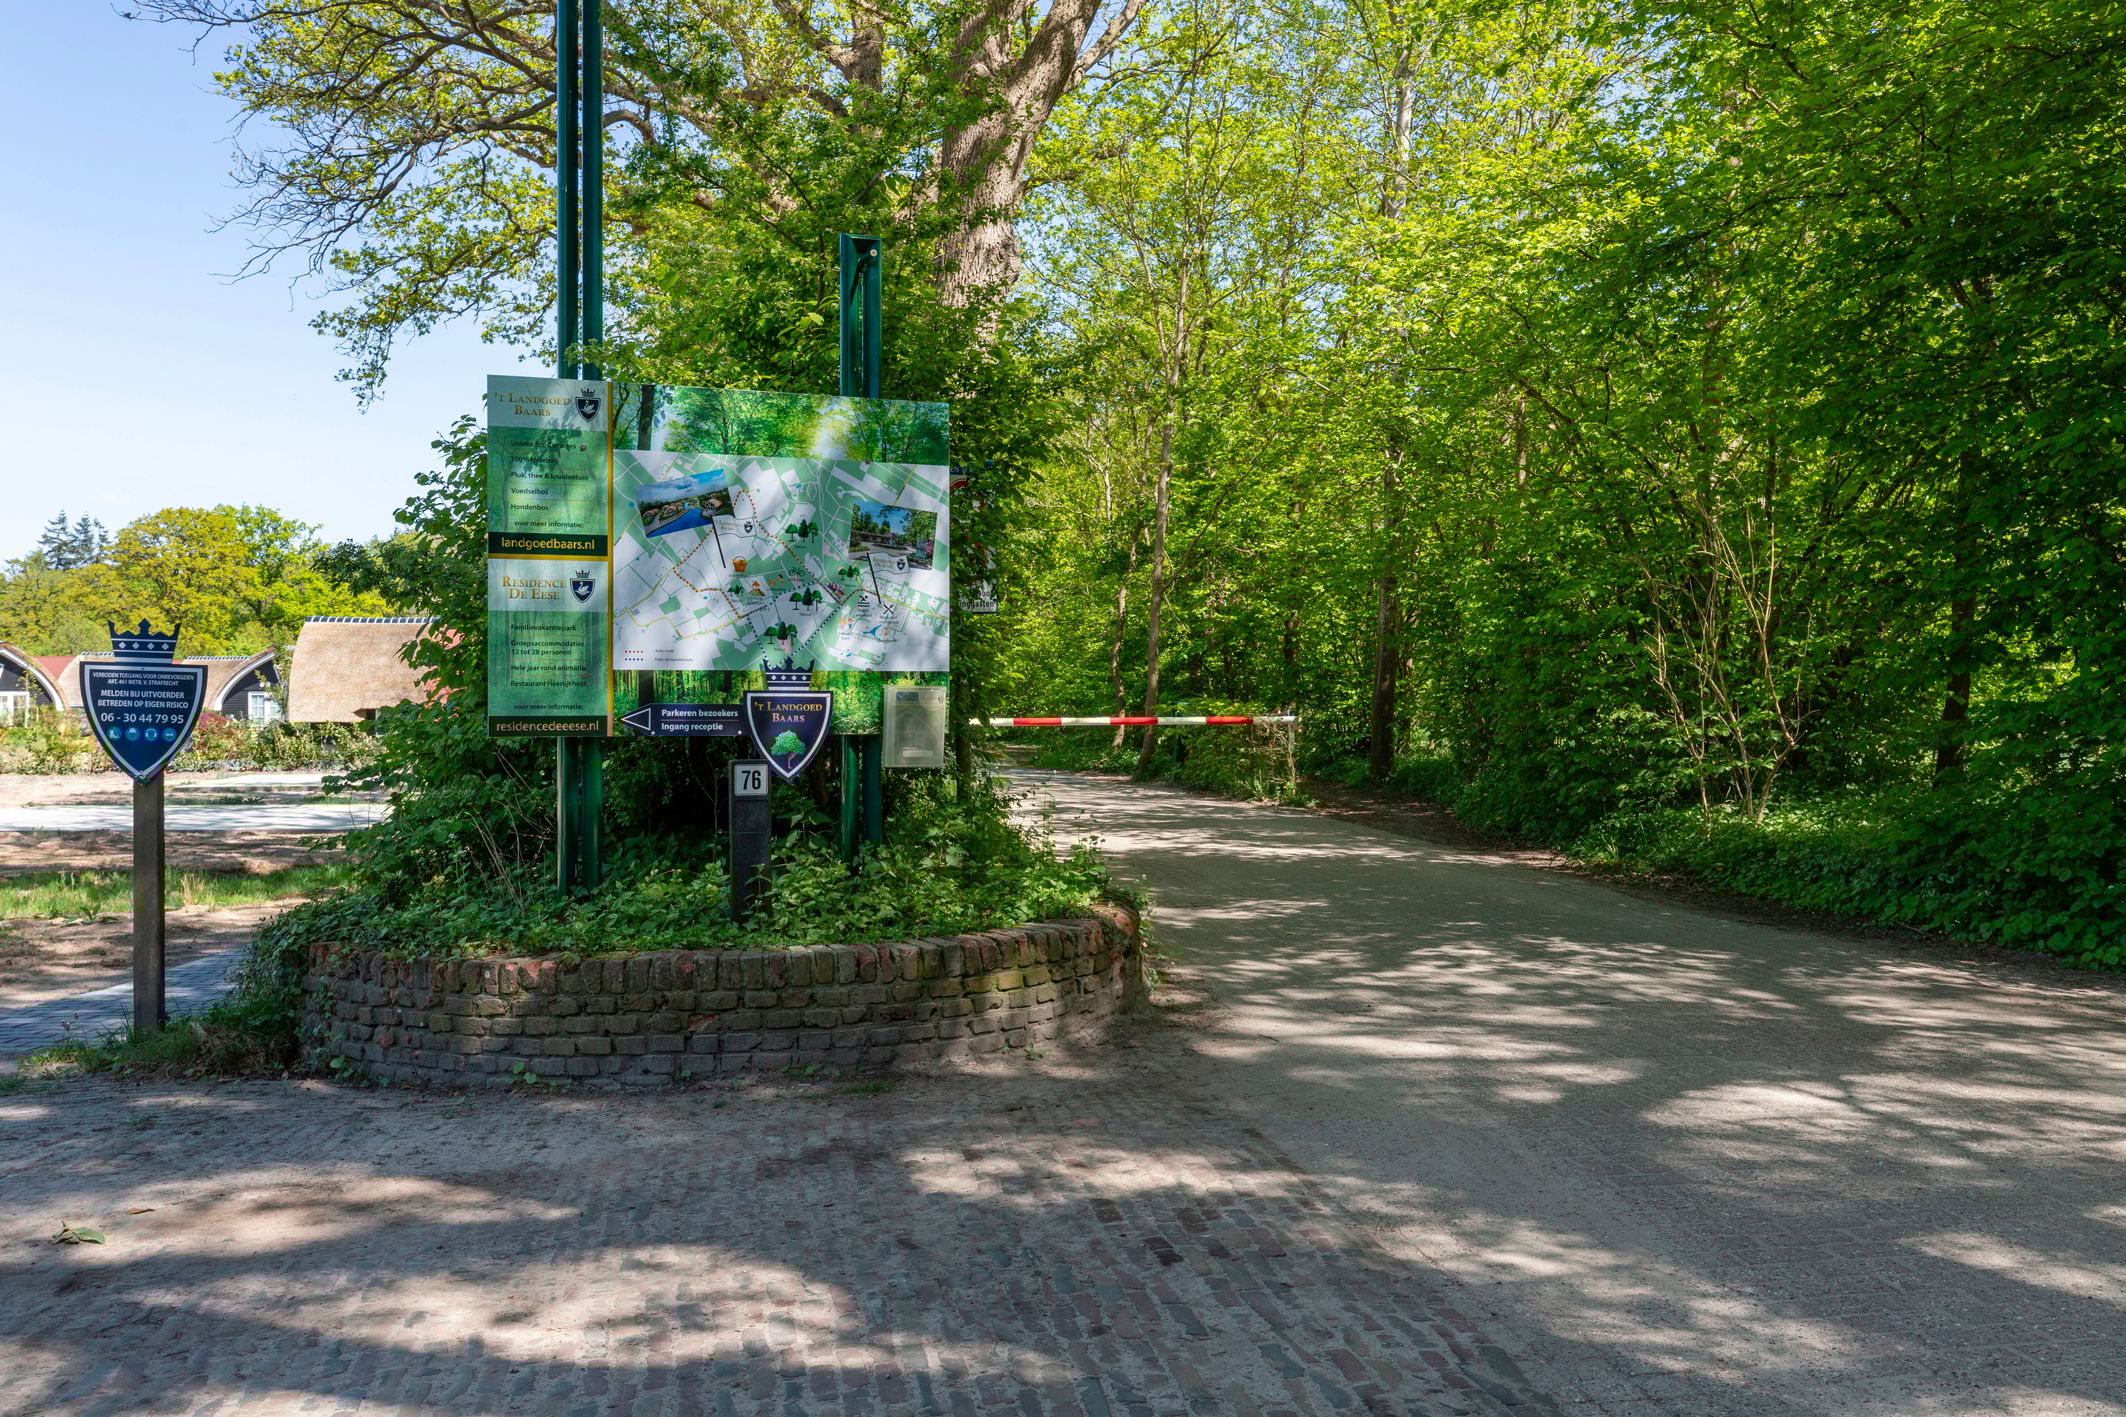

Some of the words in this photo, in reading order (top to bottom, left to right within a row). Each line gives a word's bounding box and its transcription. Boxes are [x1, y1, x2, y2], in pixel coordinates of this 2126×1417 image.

[508, 392, 571, 406] LANDGOED
[514, 405, 551, 416] BAARS
[511, 440, 534, 448] Unieke
[511, 455, 529, 463] 100%
[528, 471, 543, 479] thee
[551, 472, 589, 481] kruidentuin
[511, 487, 549, 495] Voedselbos
[511, 503, 549, 511] Hondenbos
[548, 520, 584, 529] informatie:
[501, 537, 595, 551] landgoedbaars.nl
[502, 575, 567, 588] RESIDENCE
[509, 588, 528, 599] DE
[532, 588, 560, 600] EESE
[511, 624, 577, 633] Familievakantiepark
[511, 640, 585, 649] Groepsaccommodaties
[157, 673, 194, 681] ONBEVOEGDEN
[511, 680, 546, 688] Restaurant
[101, 689, 129, 697] MELDEN
[130, 690, 140, 698] BIJ
[141, 690, 185, 699] UITVOERDER
[133, 700, 143, 708] OP
[144, 700, 165, 708] EIGEN
[166, 701, 189, 709] RISICO
[766, 701, 823, 712] LANDGOED
[100, 712, 115, 722] 06
[123, 713, 137, 722] 30
[138, 713, 153, 723] 44
[155, 714, 169, 723] 79
[170, 714, 184, 724] 95
[661, 709, 697, 717] Parkeren
[698, 709, 739, 717] bezoekers
[771, 712, 805, 722] BAARS
[496, 720, 599, 732] residencedeeese.nl
[661, 722, 690, 732] Ingang
[691, 722, 723, 732] receptie
[741, 769, 762, 790] 76
